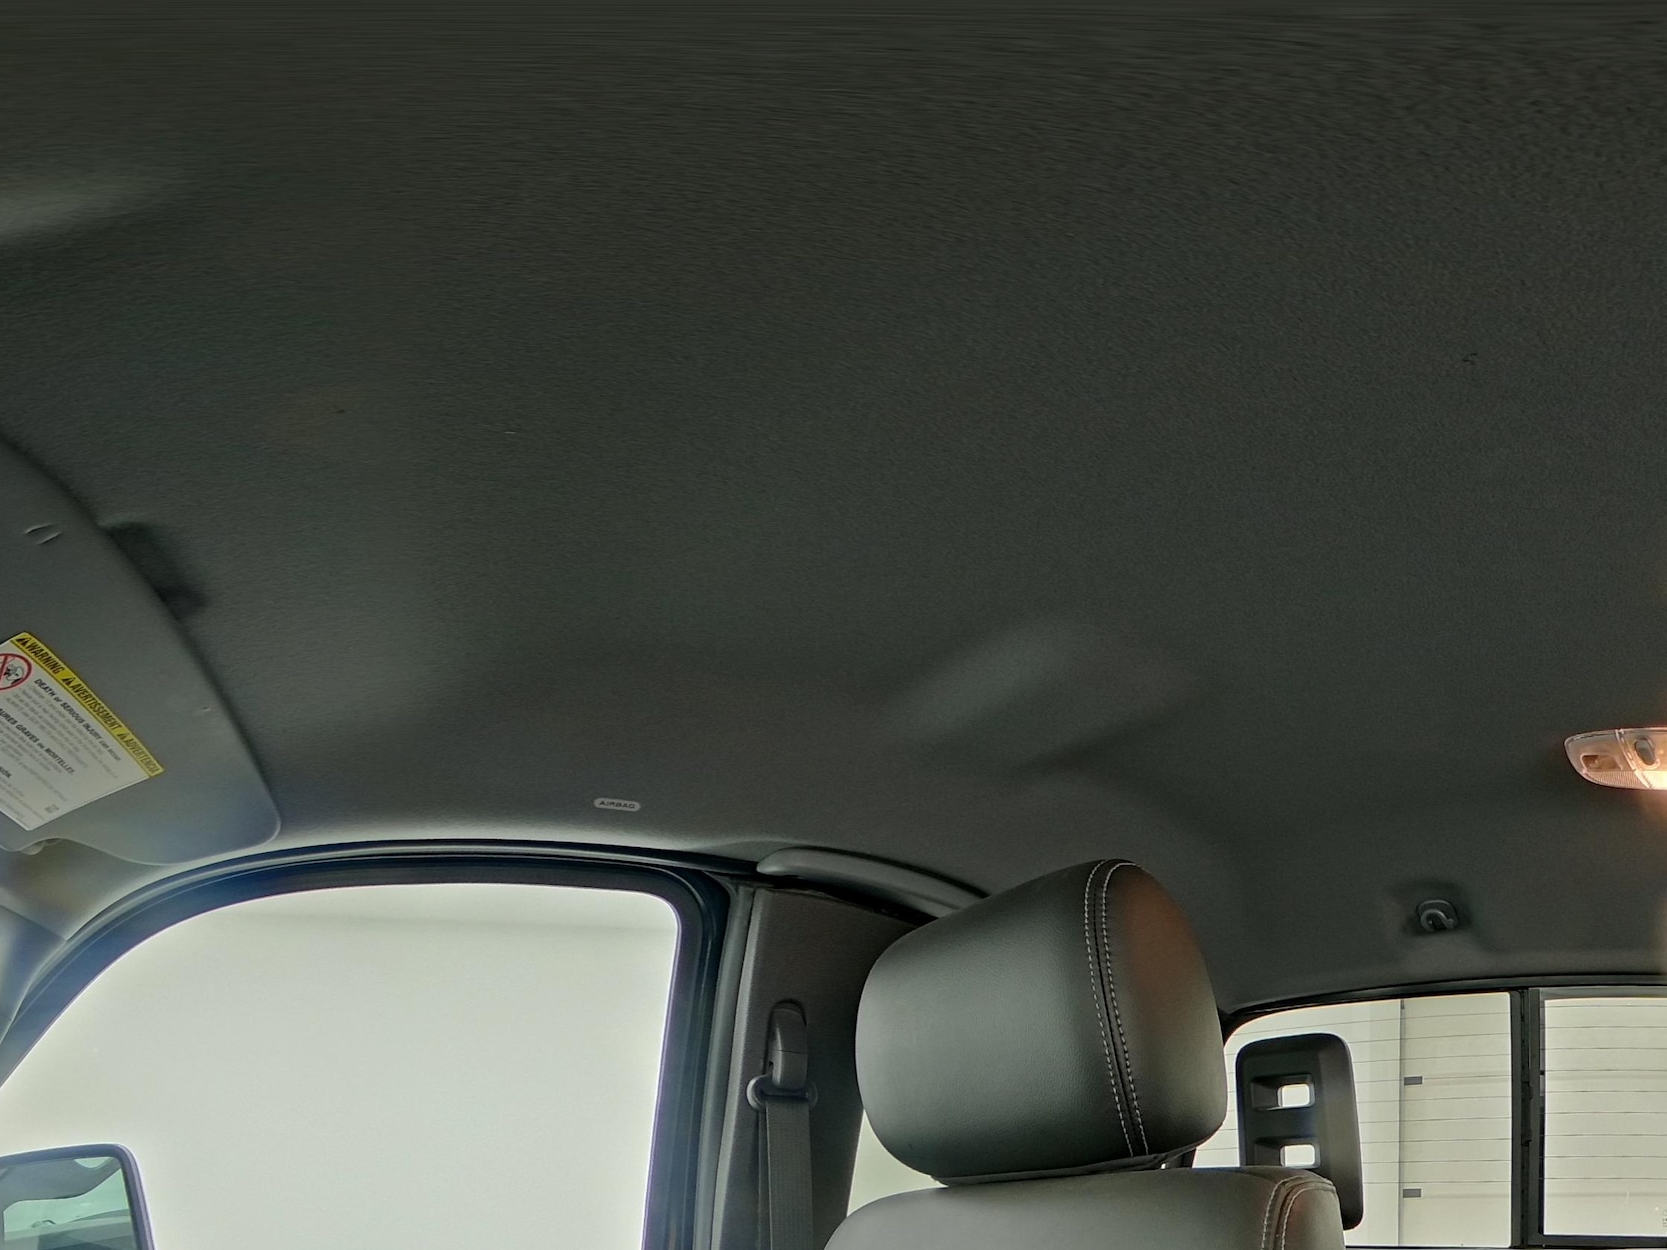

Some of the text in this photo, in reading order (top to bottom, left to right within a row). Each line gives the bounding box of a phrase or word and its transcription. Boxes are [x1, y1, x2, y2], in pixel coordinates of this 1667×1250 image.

[23, 642, 65, 674] WARNING
[68, 682, 123, 731] AVERTISSEMENT
[32, 678, 57, 697] DEATH
[58, 701, 86, 724] SERIOUS
[81, 722, 103, 740] INJURY
[13, 723, 40, 743] GRAVES
